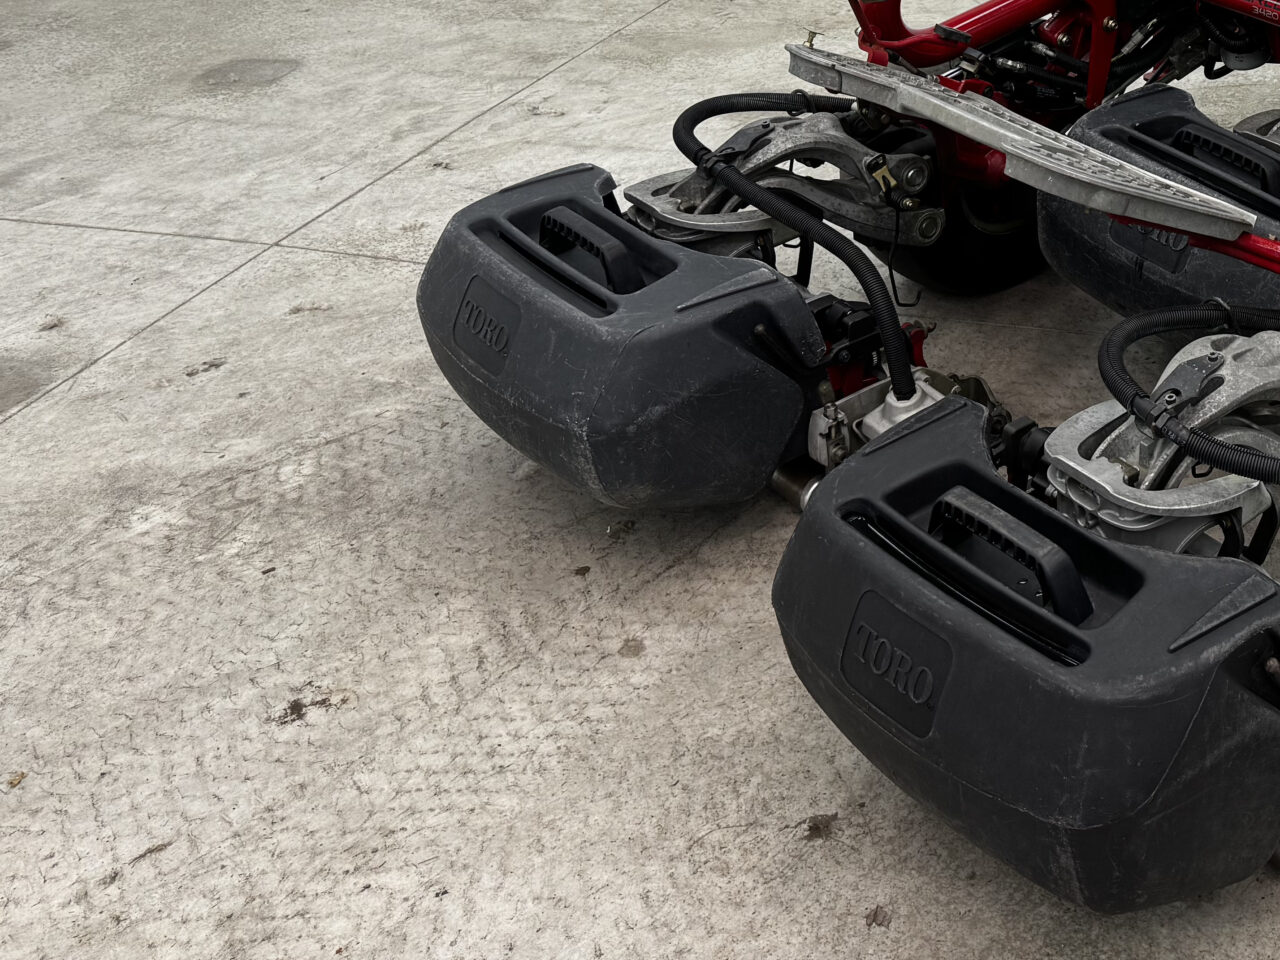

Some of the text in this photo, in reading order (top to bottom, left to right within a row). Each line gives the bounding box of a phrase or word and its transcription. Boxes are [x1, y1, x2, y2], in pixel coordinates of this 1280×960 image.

[1251, 5, 1279, 21] 3420
[464, 299, 510, 353] TORO
[854, 620, 935, 705] TORO
